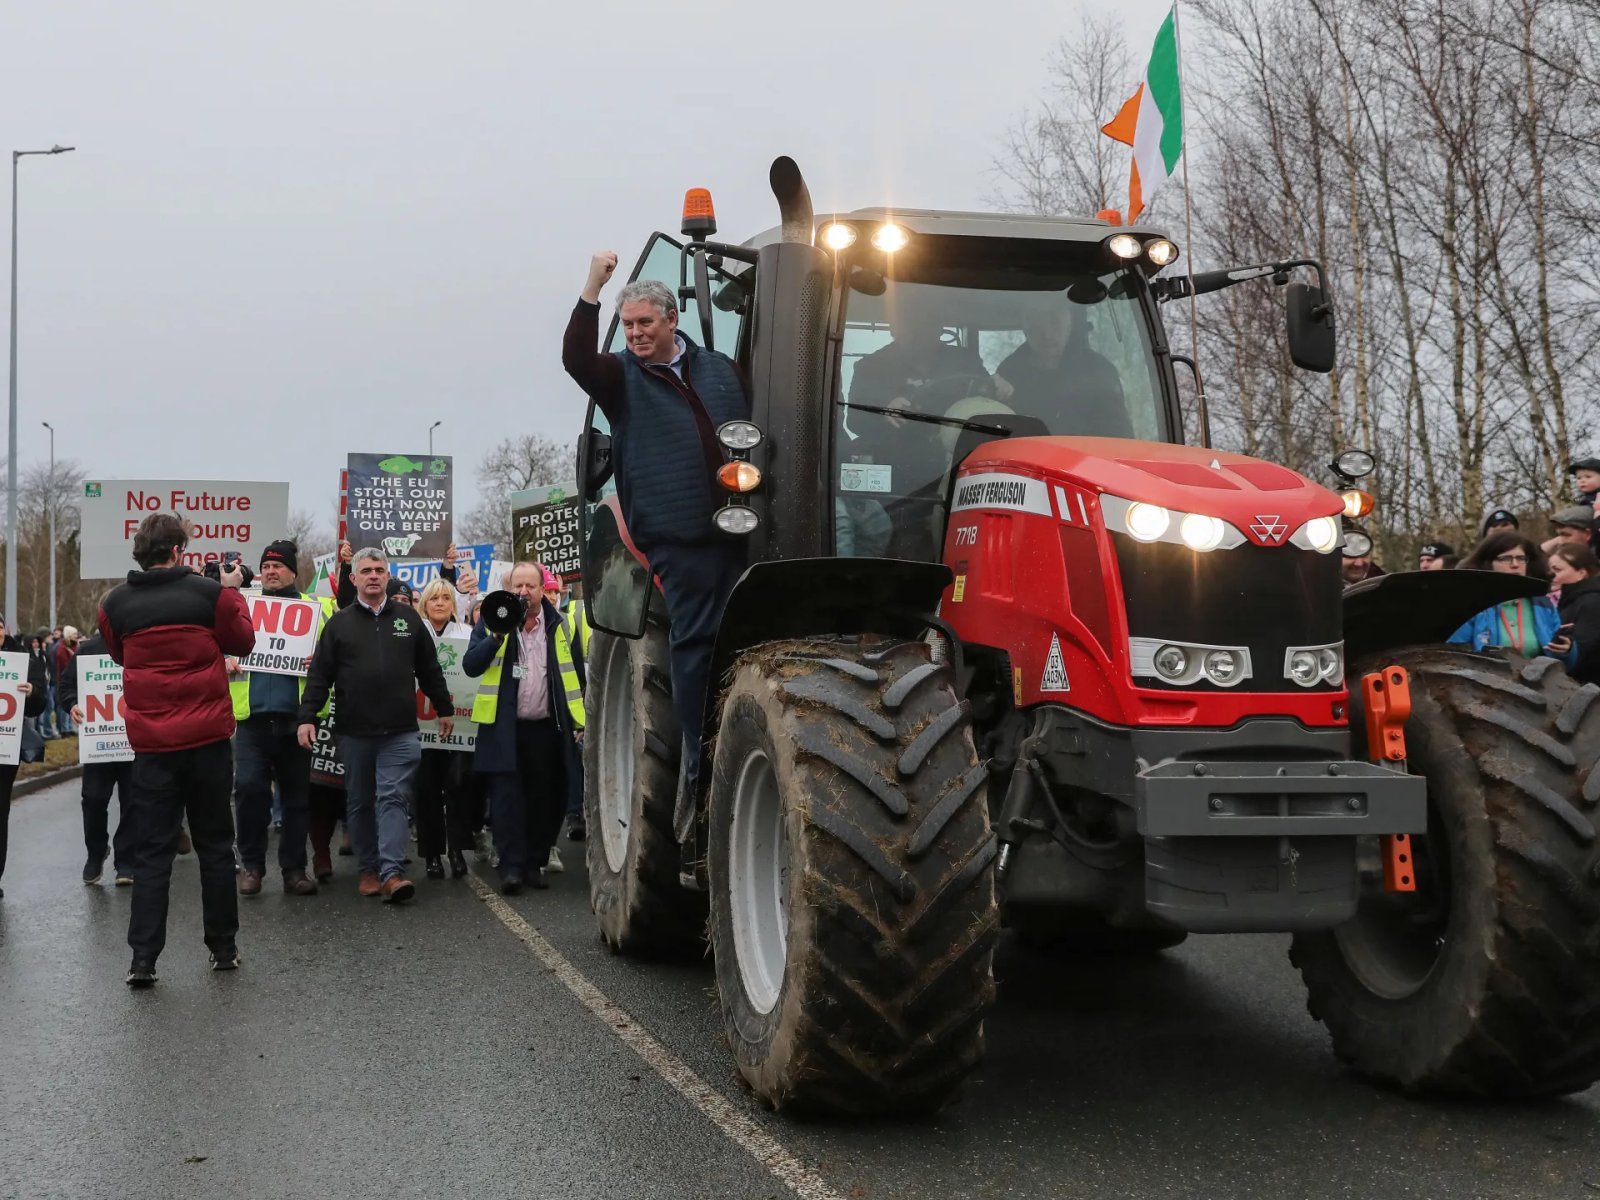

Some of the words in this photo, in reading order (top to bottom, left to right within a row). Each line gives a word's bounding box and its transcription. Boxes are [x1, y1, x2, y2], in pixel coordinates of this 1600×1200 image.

[371, 476, 402, 487] THE
[408, 478, 429, 488] EU
[126, 490, 161, 511] No
[170, 491, 252, 511] Future
[354, 487, 404, 498] STOLE
[410, 489, 447, 499] OUR
[957, 483, 987, 506] MASSEY
[984, 481, 1027, 506] FERGUSON
[357, 498, 393, 508] FISH
[400, 500, 443, 510] NOW
[351, 509, 393, 520] THEY
[398, 511, 449, 521] WANT
[193, 523, 252, 543] oung
[359, 521, 396, 531] OUR
[402, 522, 441, 532] BEEF
[535, 519, 579, 538] IRISH
[955, 525, 978, 546] 7718
[525, 534, 574, 554] FOOD
[536, 545, 580, 563] IRISH
[251, 599, 313, 637] NO
[269, 637, 286, 651] TO
[237, 652, 308, 672] MERCOSUR
[85, 671, 122, 682] Farm
[85, 694, 127, 723] N
[84, 726, 95, 734] to
[99, 725, 126, 733] Merc
[106, 740, 130, 749] EASYF
